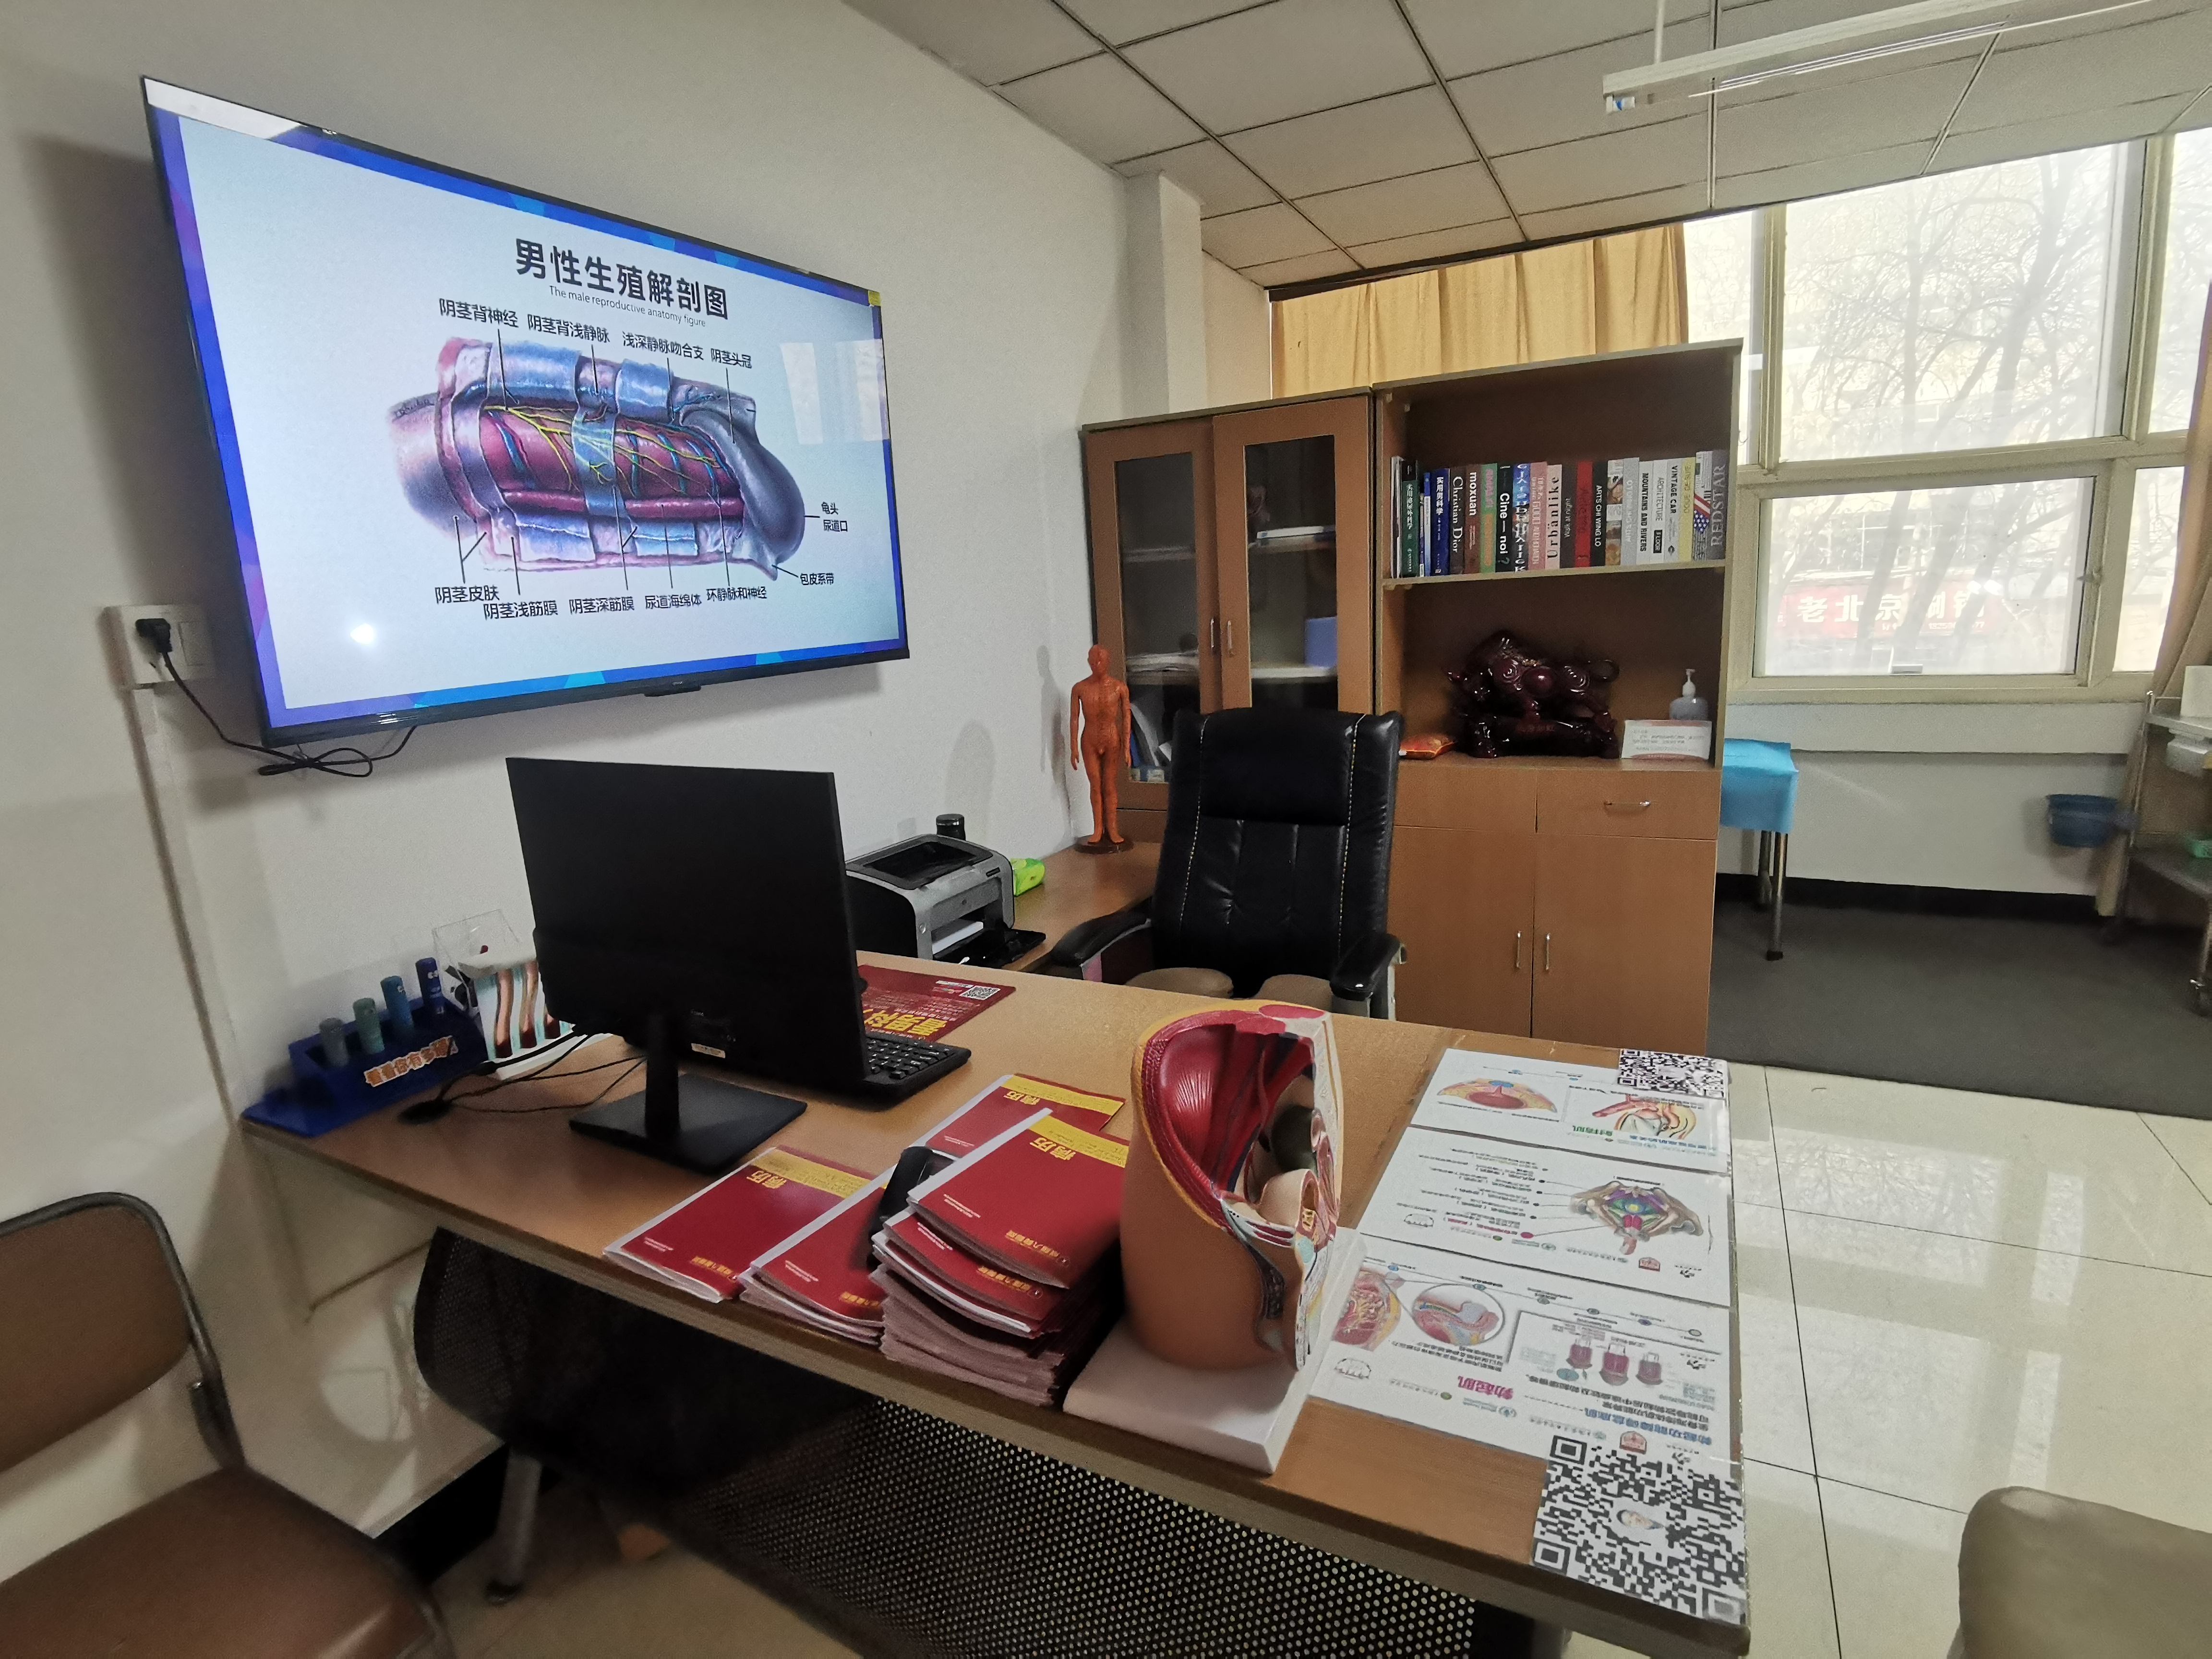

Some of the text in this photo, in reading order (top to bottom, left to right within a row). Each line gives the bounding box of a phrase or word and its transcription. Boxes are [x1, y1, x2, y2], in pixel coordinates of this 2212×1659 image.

[515, 238, 728, 320] 男性生殖解剖图
[439, 298, 519, 328] 阴茎背神经
[549, 285, 706, 327] The male reproductive anatomy figure
[527, 313, 610, 343] 阴茎背浅静脉
[622, 330, 704, 361] 浅深静脉吻合支
[710, 348, 752, 369] 阴茎头冠
[821, 501, 839, 516] 龟头
[1655, 477, 1665, 521] ARCHITECTURE
[1452, 476, 1464, 553] Christian Dior
[822, 519, 849, 532] 尿道口
[799, 572, 834, 587] 包皮系带
[434, 585, 500, 604] 阴茎皮肤
[644, 592, 702, 610] 尿道海绵体
[705, 586, 767, 601] 环静脉和神经
[483, 599, 558, 621] 阴茎浅筋膜
[569, 597, 635, 614] 阴茎深筋膜
[1003, 1090, 1041, 1106] 病历
[1029, 1137, 1076, 1160] 病历
[745, 1170, 787, 1189] 病历
